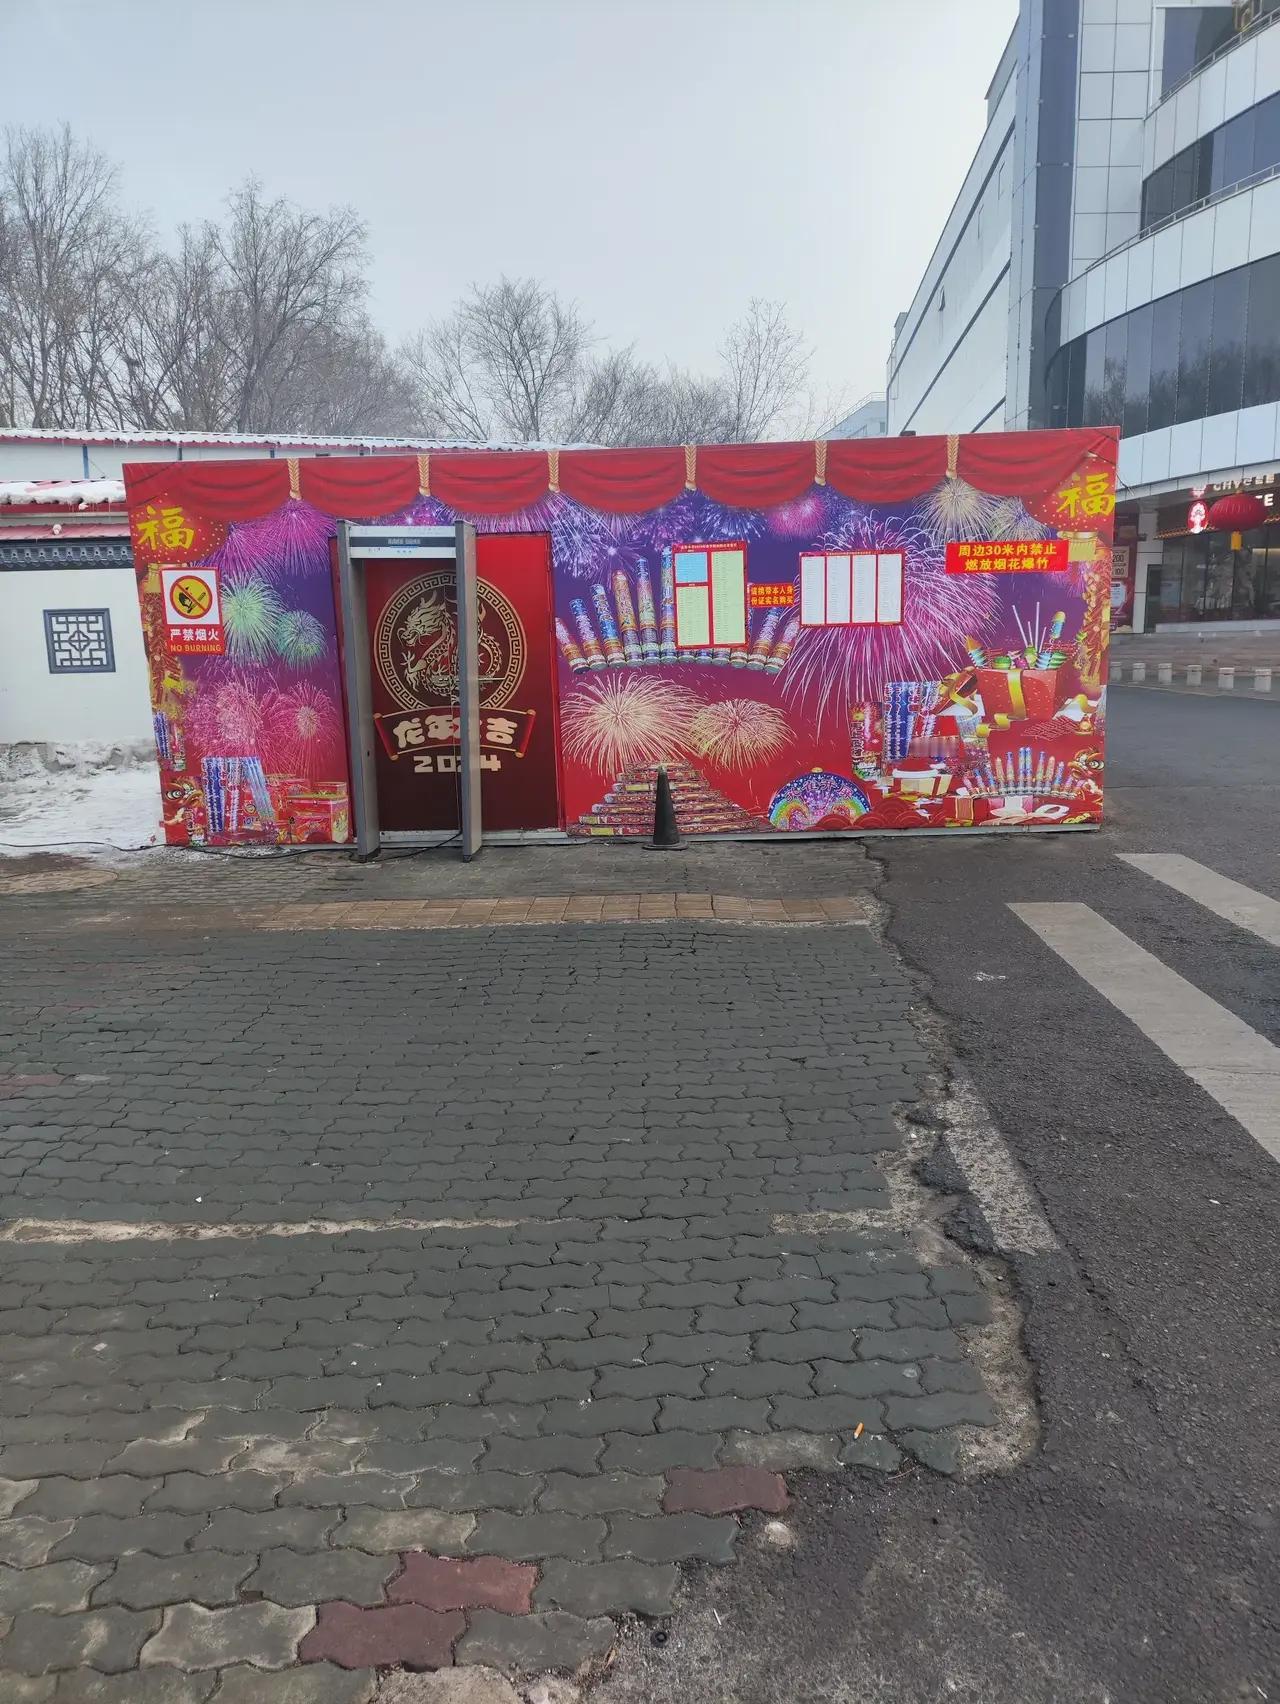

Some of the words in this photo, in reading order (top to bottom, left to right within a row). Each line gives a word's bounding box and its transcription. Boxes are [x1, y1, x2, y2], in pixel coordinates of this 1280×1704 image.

[1058, 471, 1115, 519] 福
[135, 504, 195, 551] 福
[958, 543, 1057, 557] 周边30米内禁止
[965, 557, 1050, 571] 燃放烟花爆竹
[170, 628, 219, 641] 严禁烟火
[170, 644, 182, 652] NO
[185, 644, 221, 652] BURNING
[413, 754, 502, 773] 204
